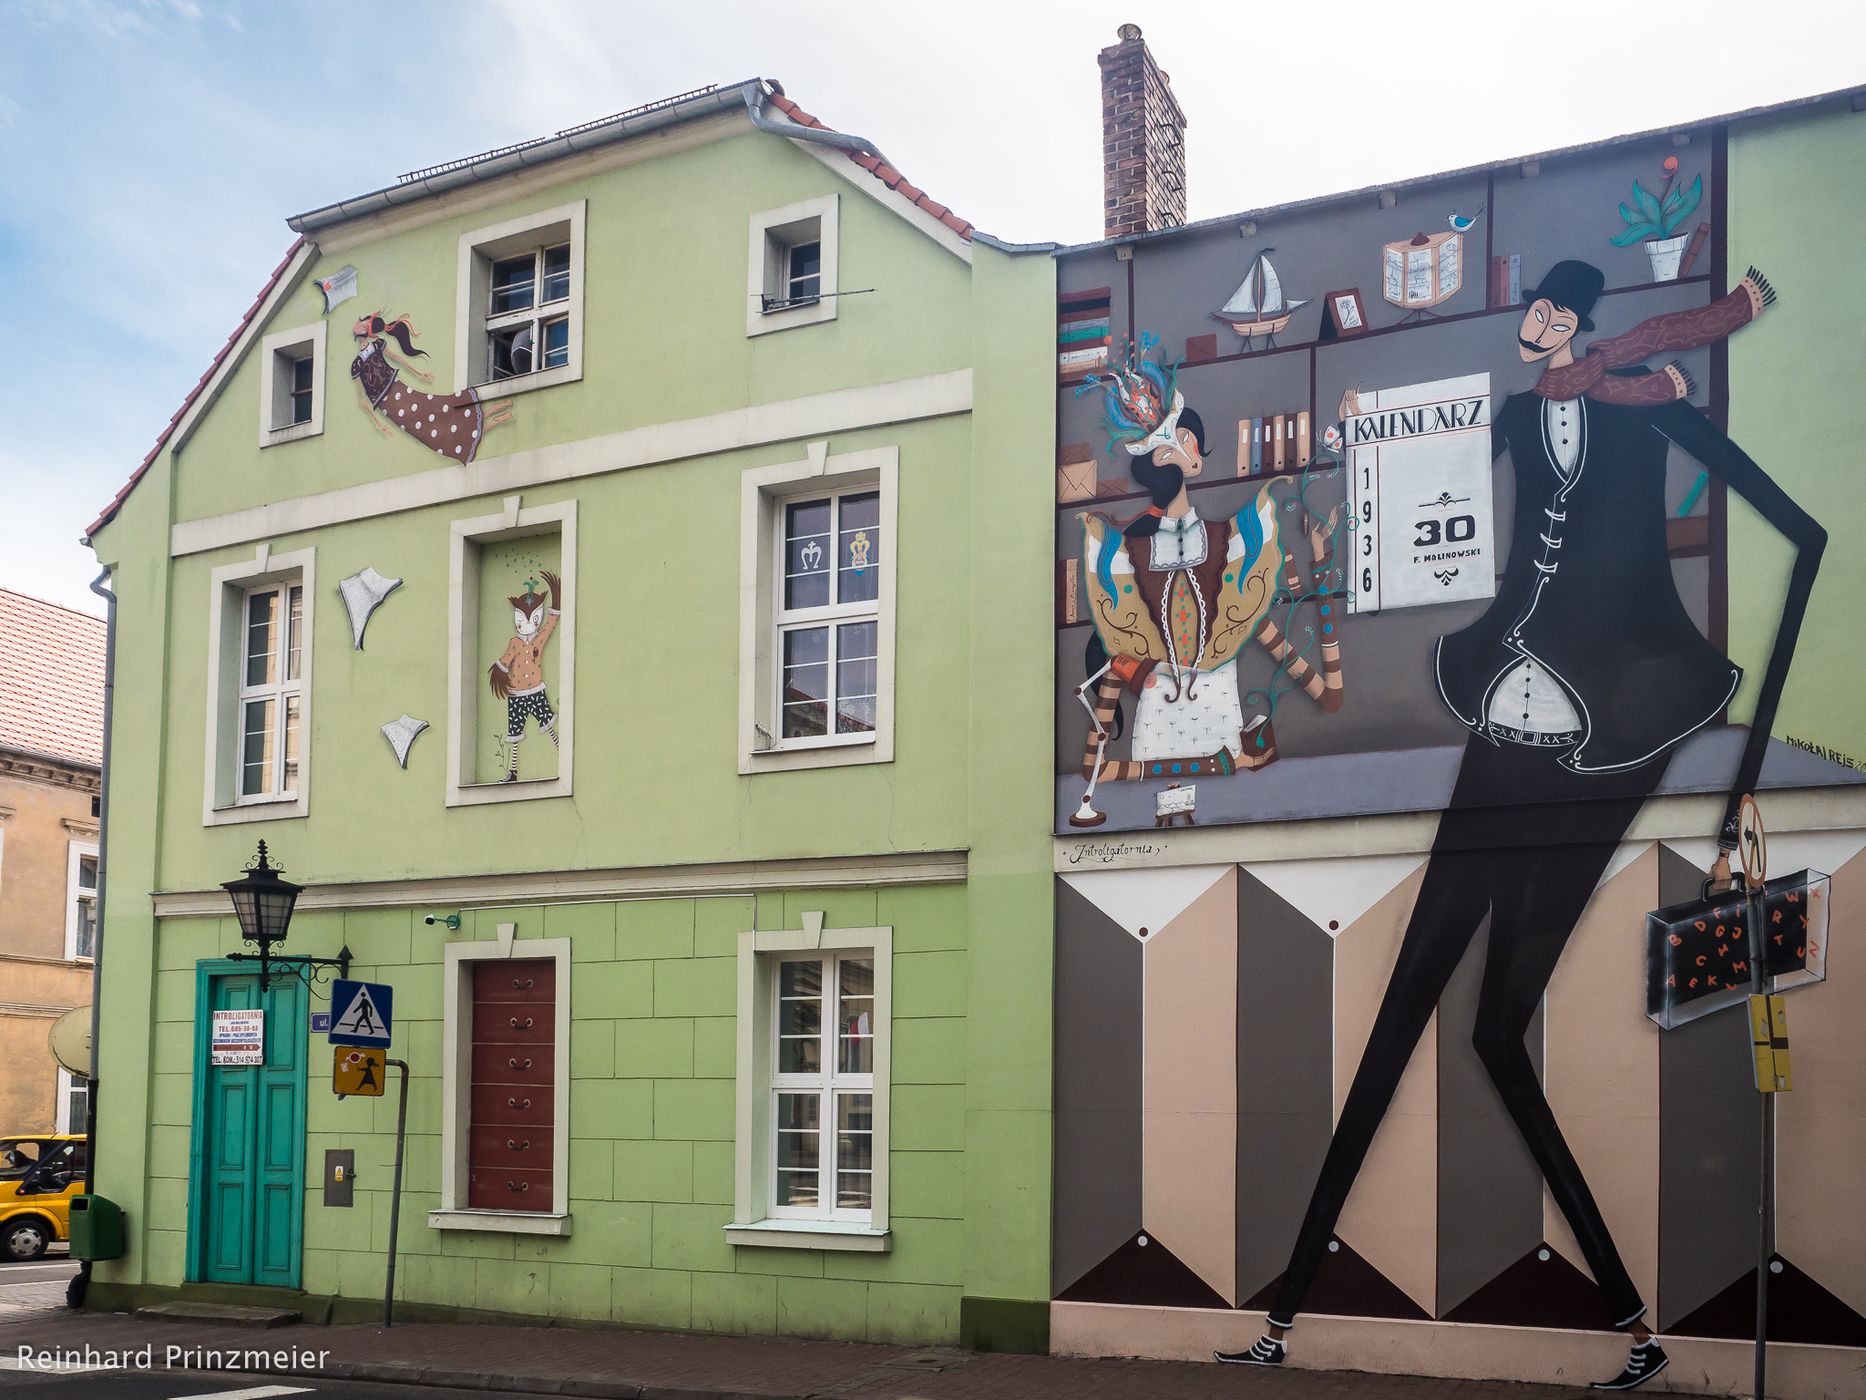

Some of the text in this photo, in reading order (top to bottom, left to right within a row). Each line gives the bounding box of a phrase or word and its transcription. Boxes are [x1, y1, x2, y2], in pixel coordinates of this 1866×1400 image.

[1354, 399, 1484, 444] KALENDARZ
[1413, 514, 1476, 547] 30
[1413, 548, 1481, 564] F. MALINOWSKI
